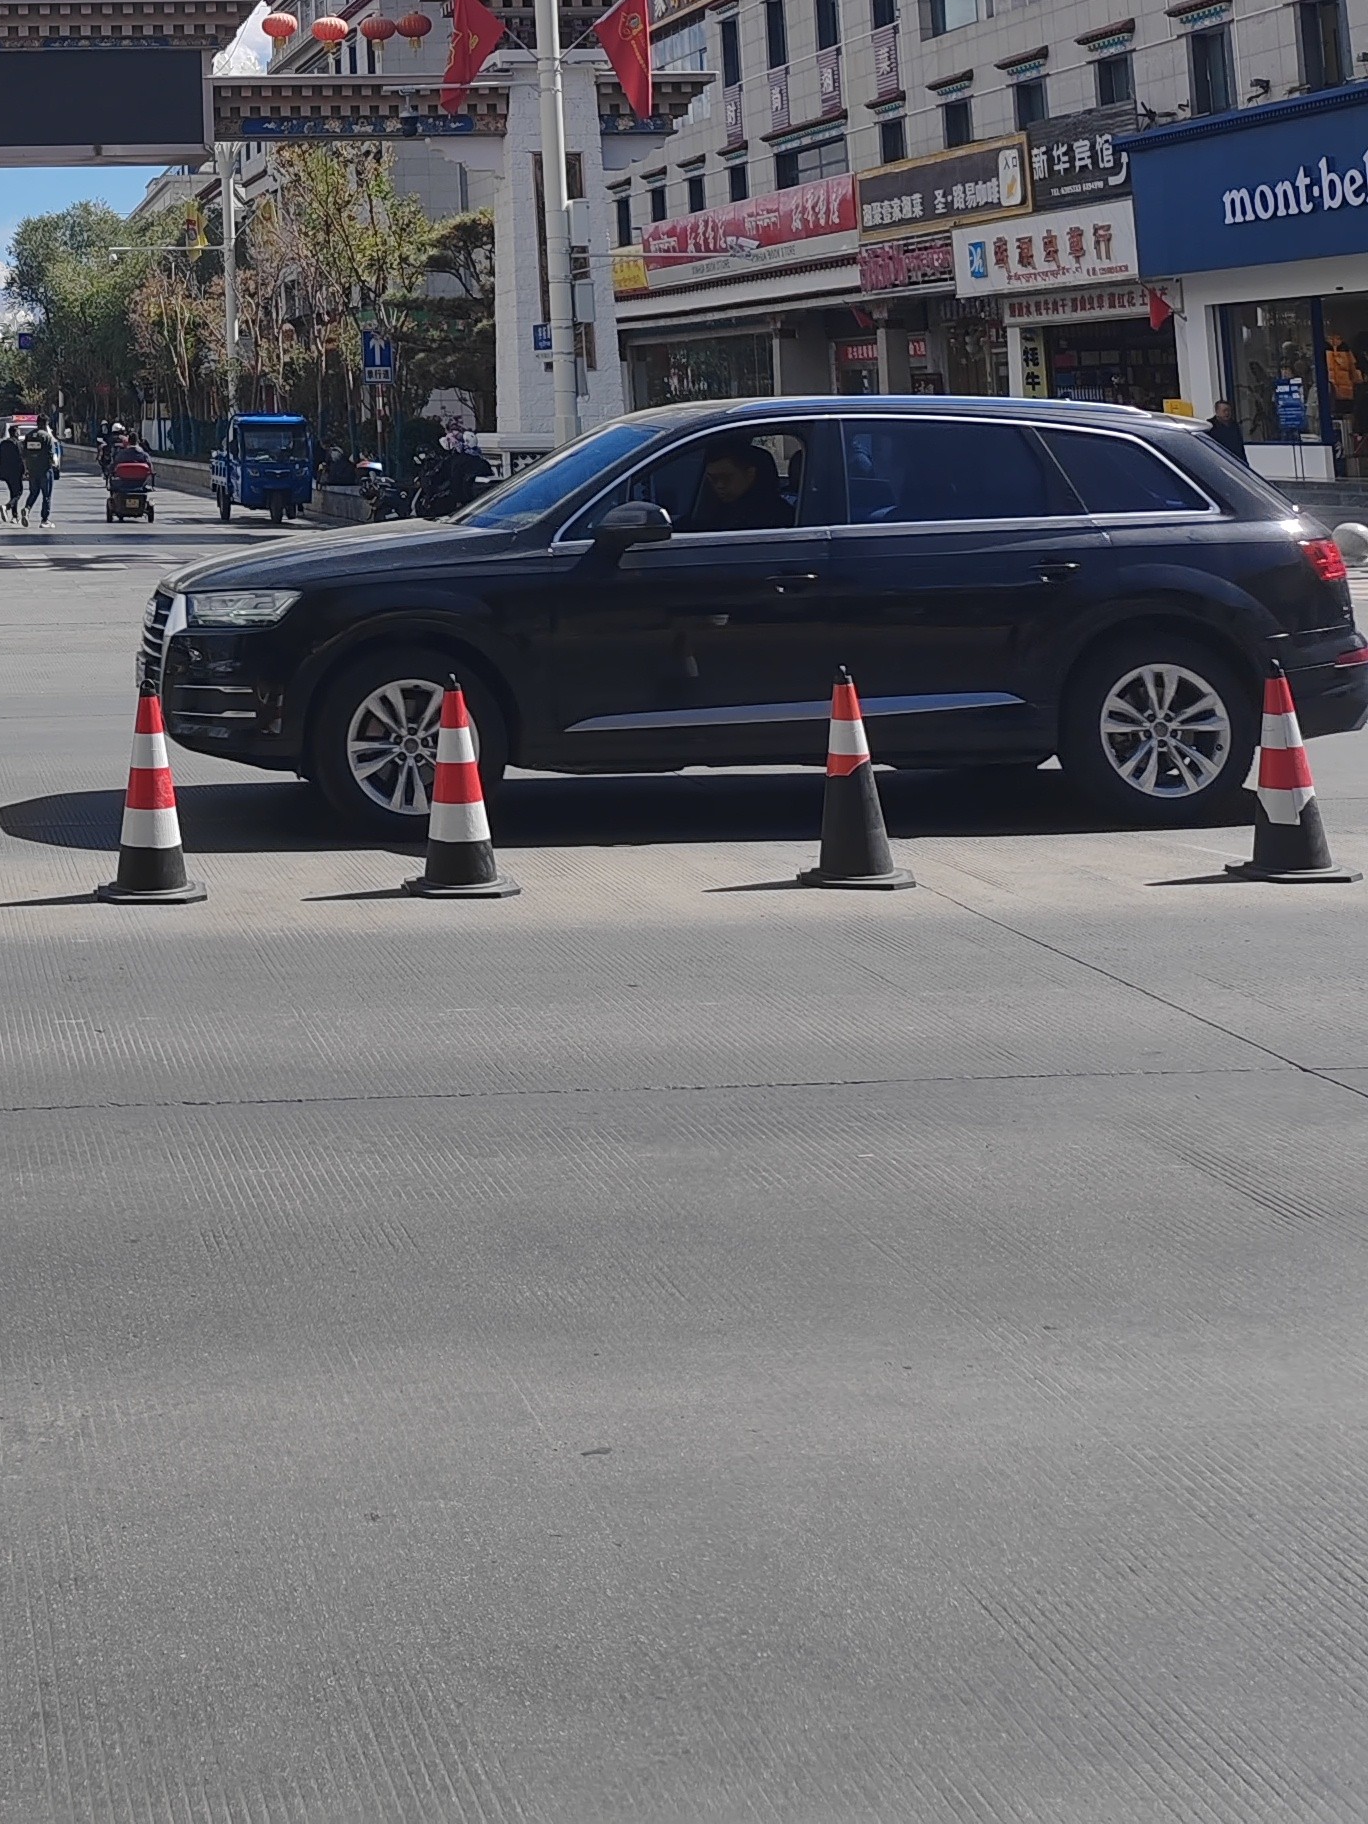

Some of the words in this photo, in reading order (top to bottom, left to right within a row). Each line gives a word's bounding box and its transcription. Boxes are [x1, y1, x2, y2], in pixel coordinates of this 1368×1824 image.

[1003, 155, 1018, 171] 入口
[1031, 133, 1114, 182] 新华宾馆
